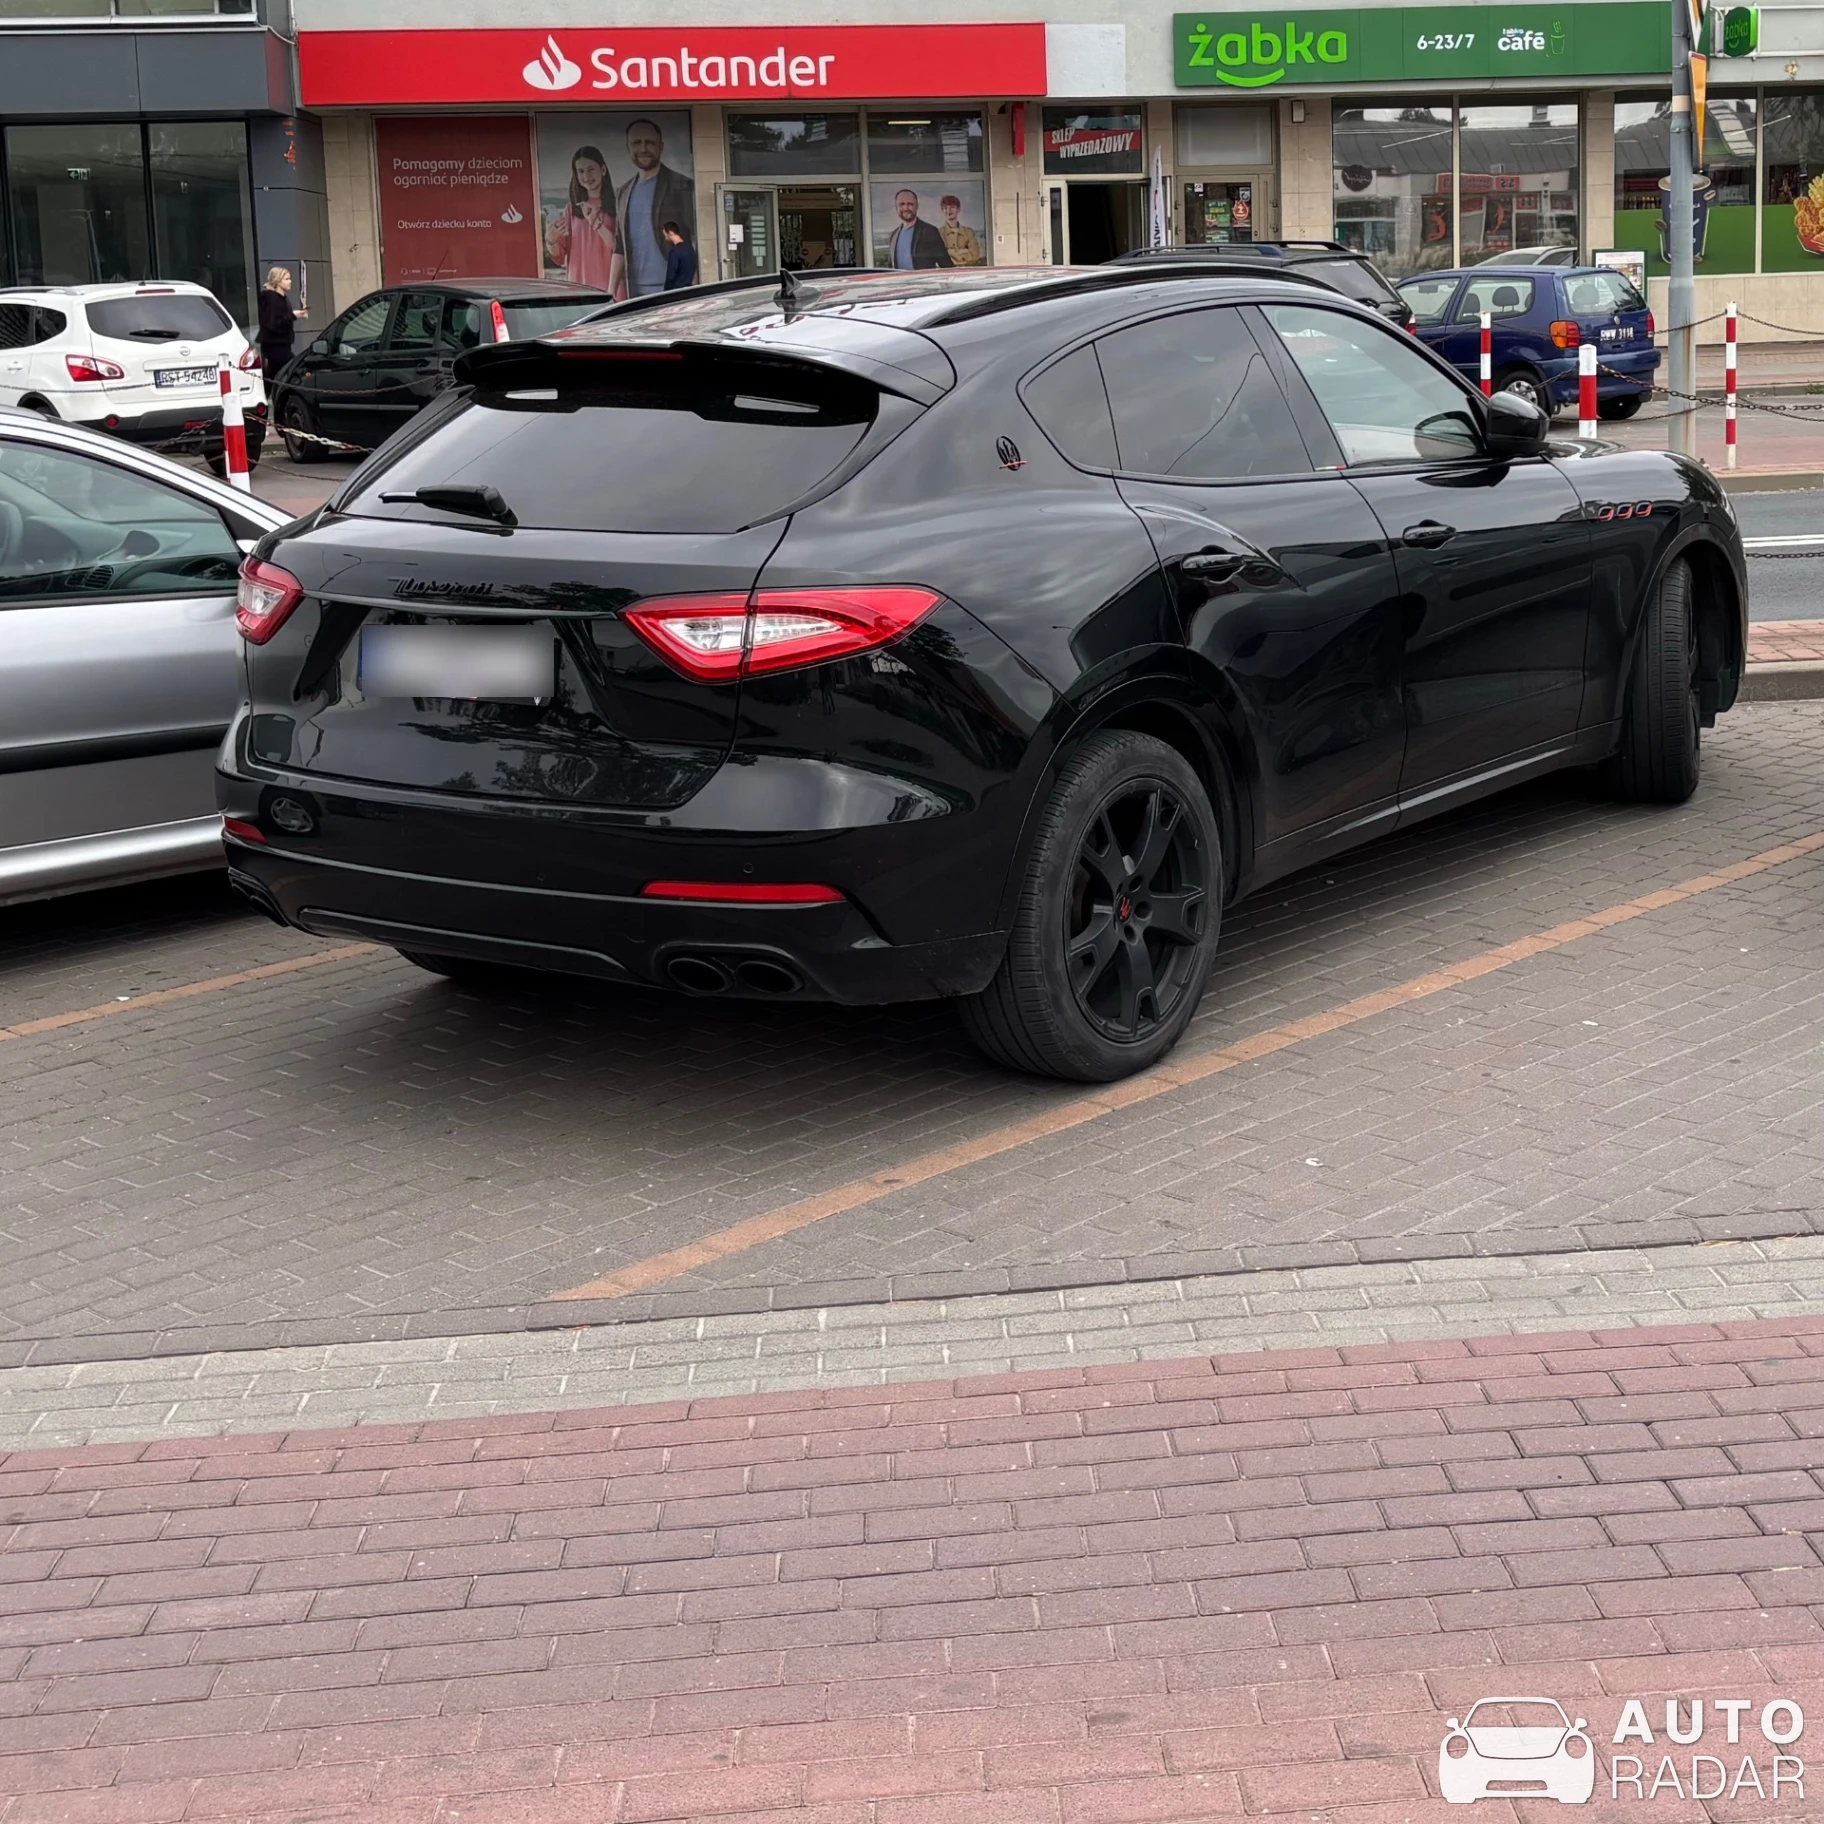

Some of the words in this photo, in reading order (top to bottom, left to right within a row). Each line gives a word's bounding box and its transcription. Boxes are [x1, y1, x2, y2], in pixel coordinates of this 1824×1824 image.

[1188, 21, 1347, 67] żabka
[1416, 33, 1476, 51] 6-23/7
[1497, 30, 1546, 52] café
[590, 46, 836, 90] Santander
[1051, 126, 1076, 145] SKLEP
[1060, 132, 1134, 159] WYPRZEDAŻOWY
[393, 157, 465, 173] Pomagamy
[468, 156, 523, 169] dzieciom
[393, 172, 448, 188] ogarniać
[450, 172, 509, 187] pieniądze
[397, 219, 431, 230] Otwórz
[432, 219, 466, 230] dziecku
[466, 219, 492, 229] konto
